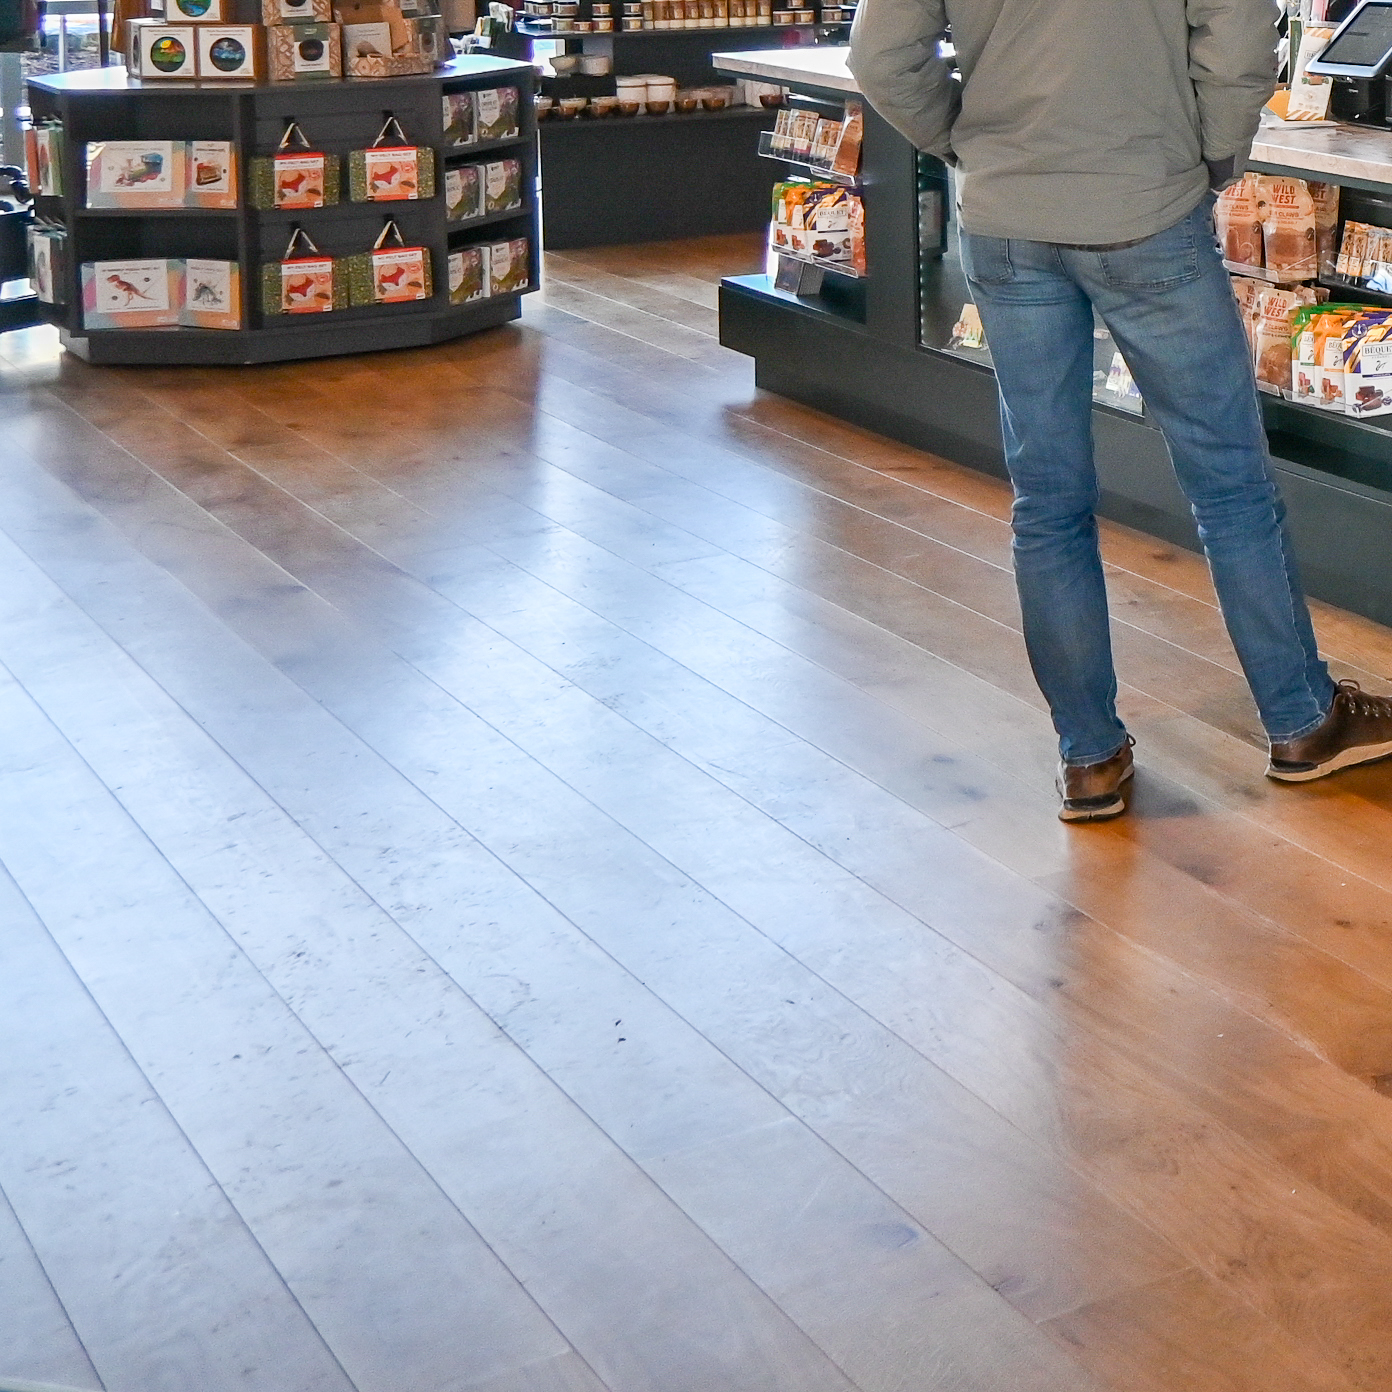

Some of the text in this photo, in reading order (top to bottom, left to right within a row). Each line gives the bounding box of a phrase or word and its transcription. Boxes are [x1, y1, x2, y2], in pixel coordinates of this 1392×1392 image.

[1273, 184, 1295, 195] WILD
[1271, 194, 1297, 205] WEST
[1267, 296, 1288, 309] WILD
[1264, 307, 1286, 317] WEST
